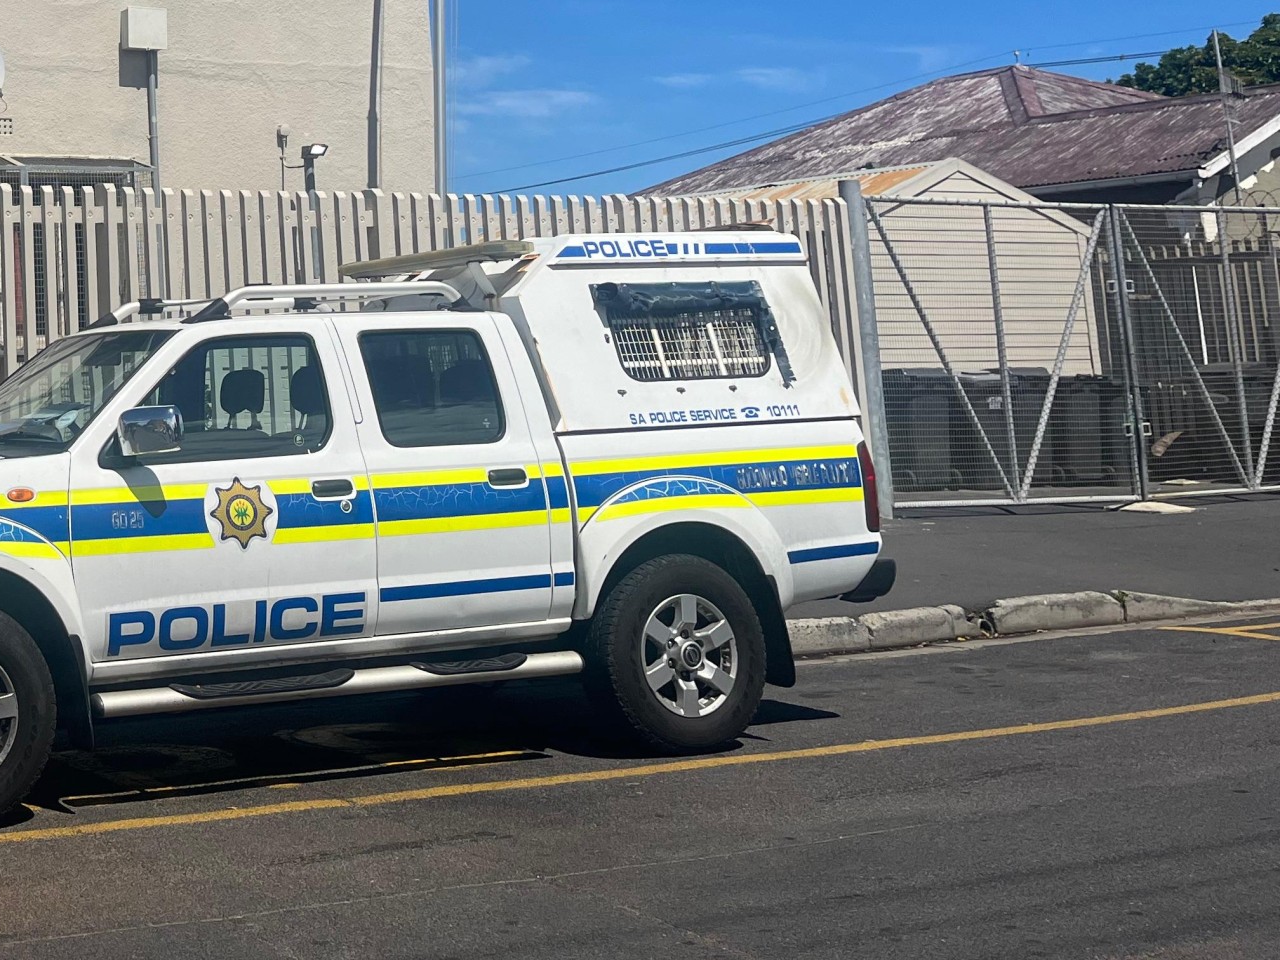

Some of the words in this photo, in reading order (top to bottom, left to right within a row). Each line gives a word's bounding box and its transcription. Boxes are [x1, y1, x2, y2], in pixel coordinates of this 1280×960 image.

[582, 240, 668, 258] POLICE
[629, 413, 647, 425] SA
[650, 411, 688, 424] POLICE
[690, 408, 737, 421] SERVICE
[766, 404, 801, 417] 10111
[107, 591, 367, 657] POLICE
